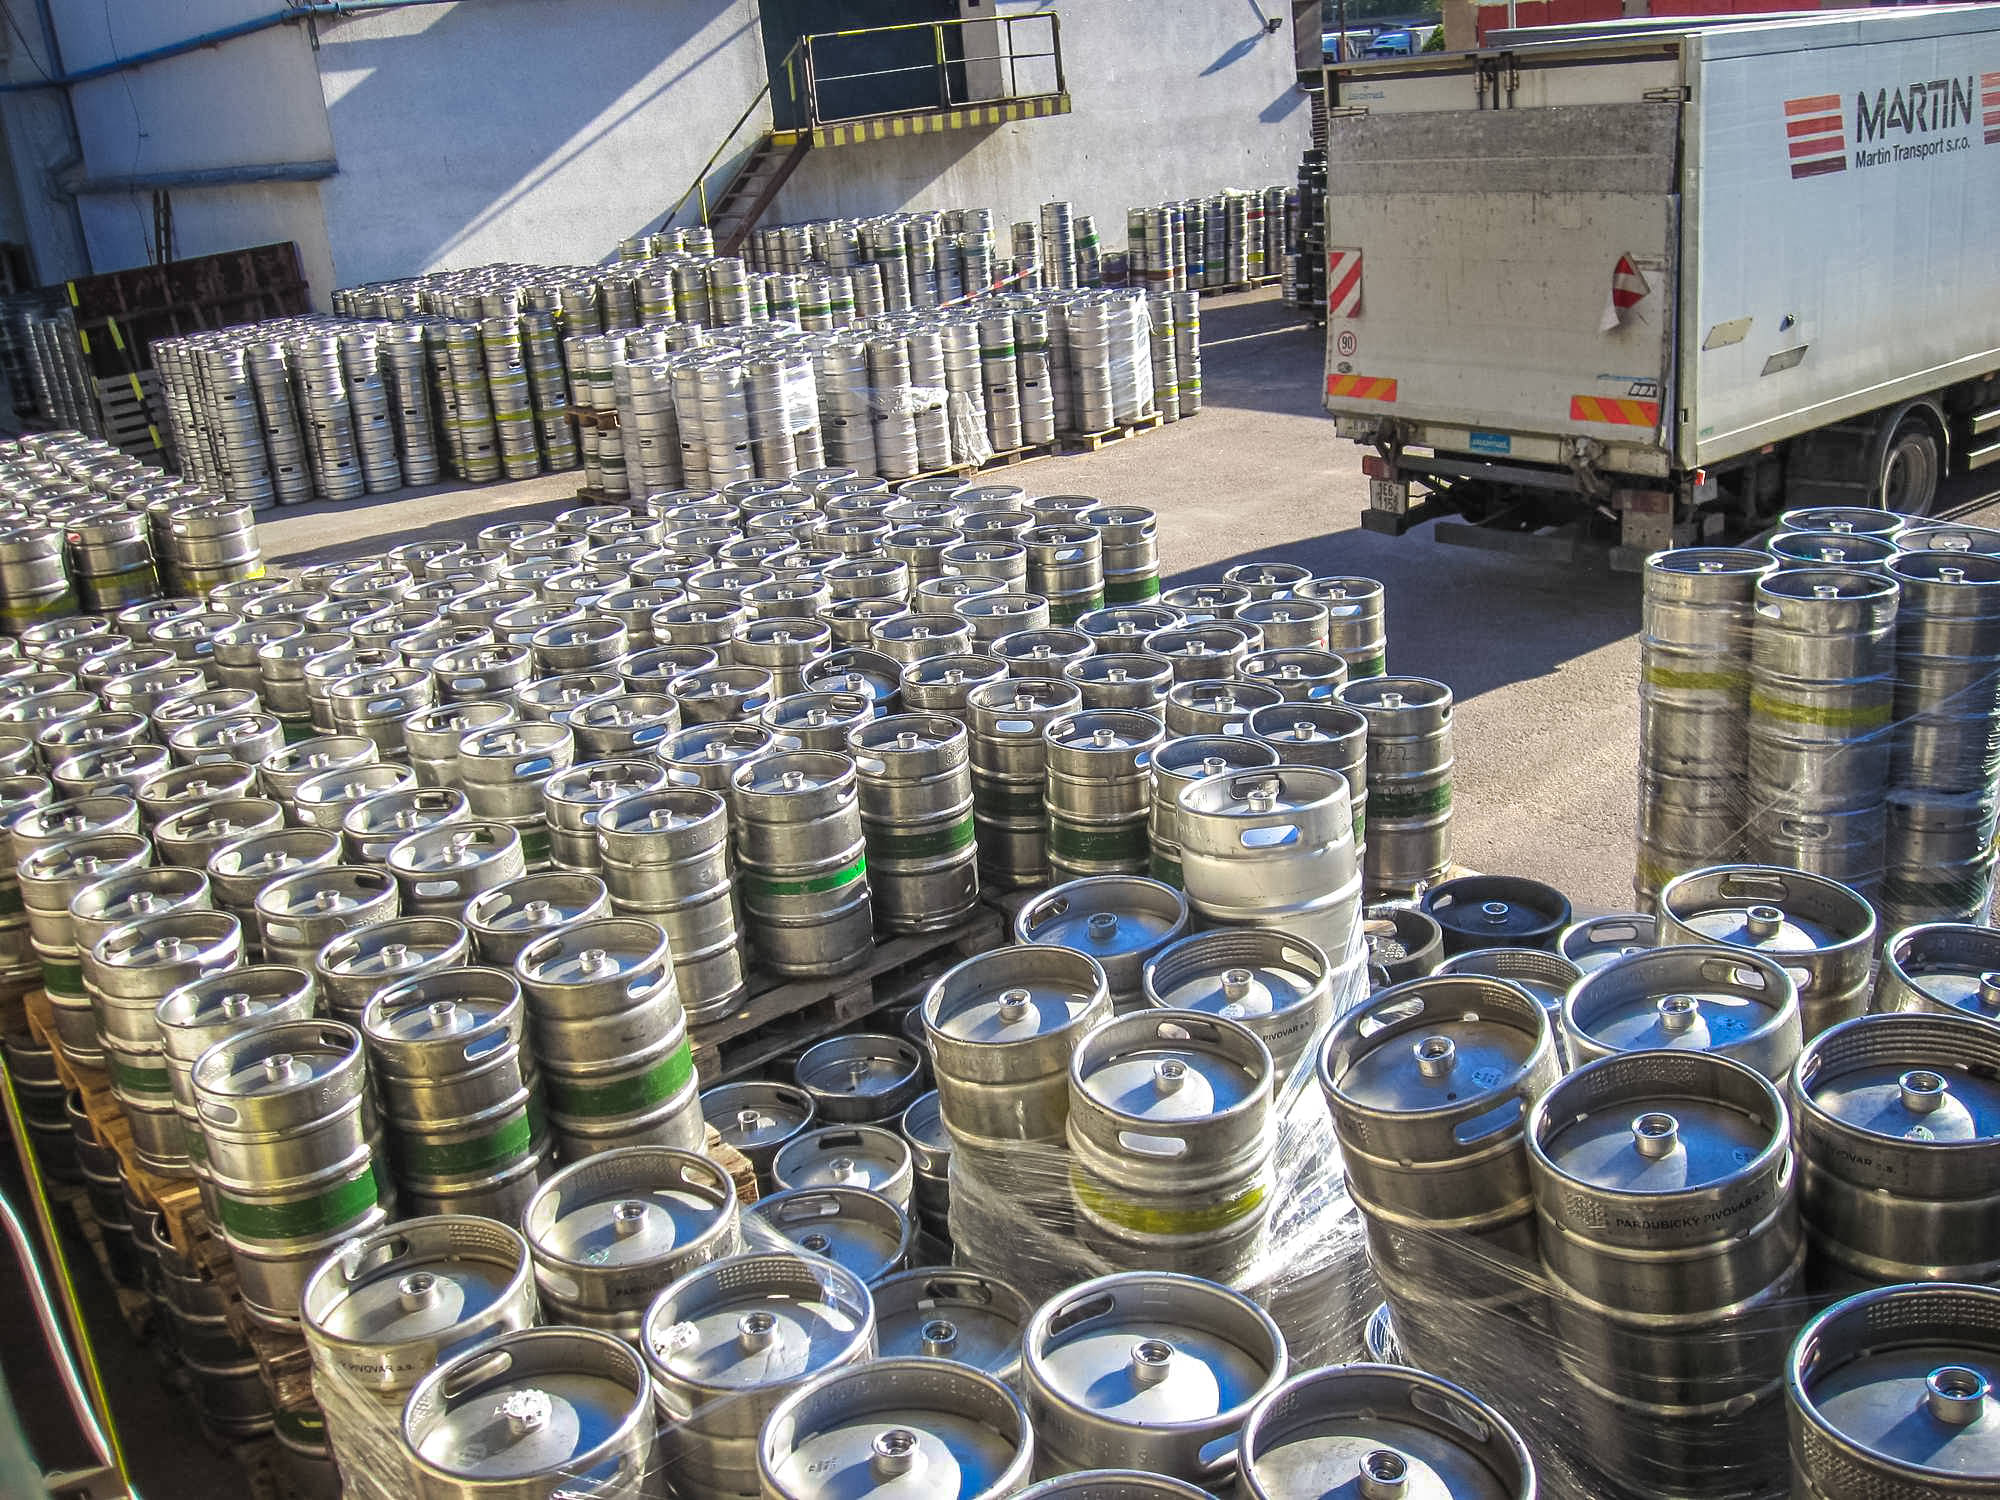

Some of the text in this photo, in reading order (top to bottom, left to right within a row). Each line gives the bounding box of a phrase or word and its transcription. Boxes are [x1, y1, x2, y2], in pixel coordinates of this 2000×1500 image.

[1856, 75, 1973, 143] MARTIN
[1855, 136, 1970, 168] Martin Transport s.r.o.
[1341, 335, 1353, 350] 90
